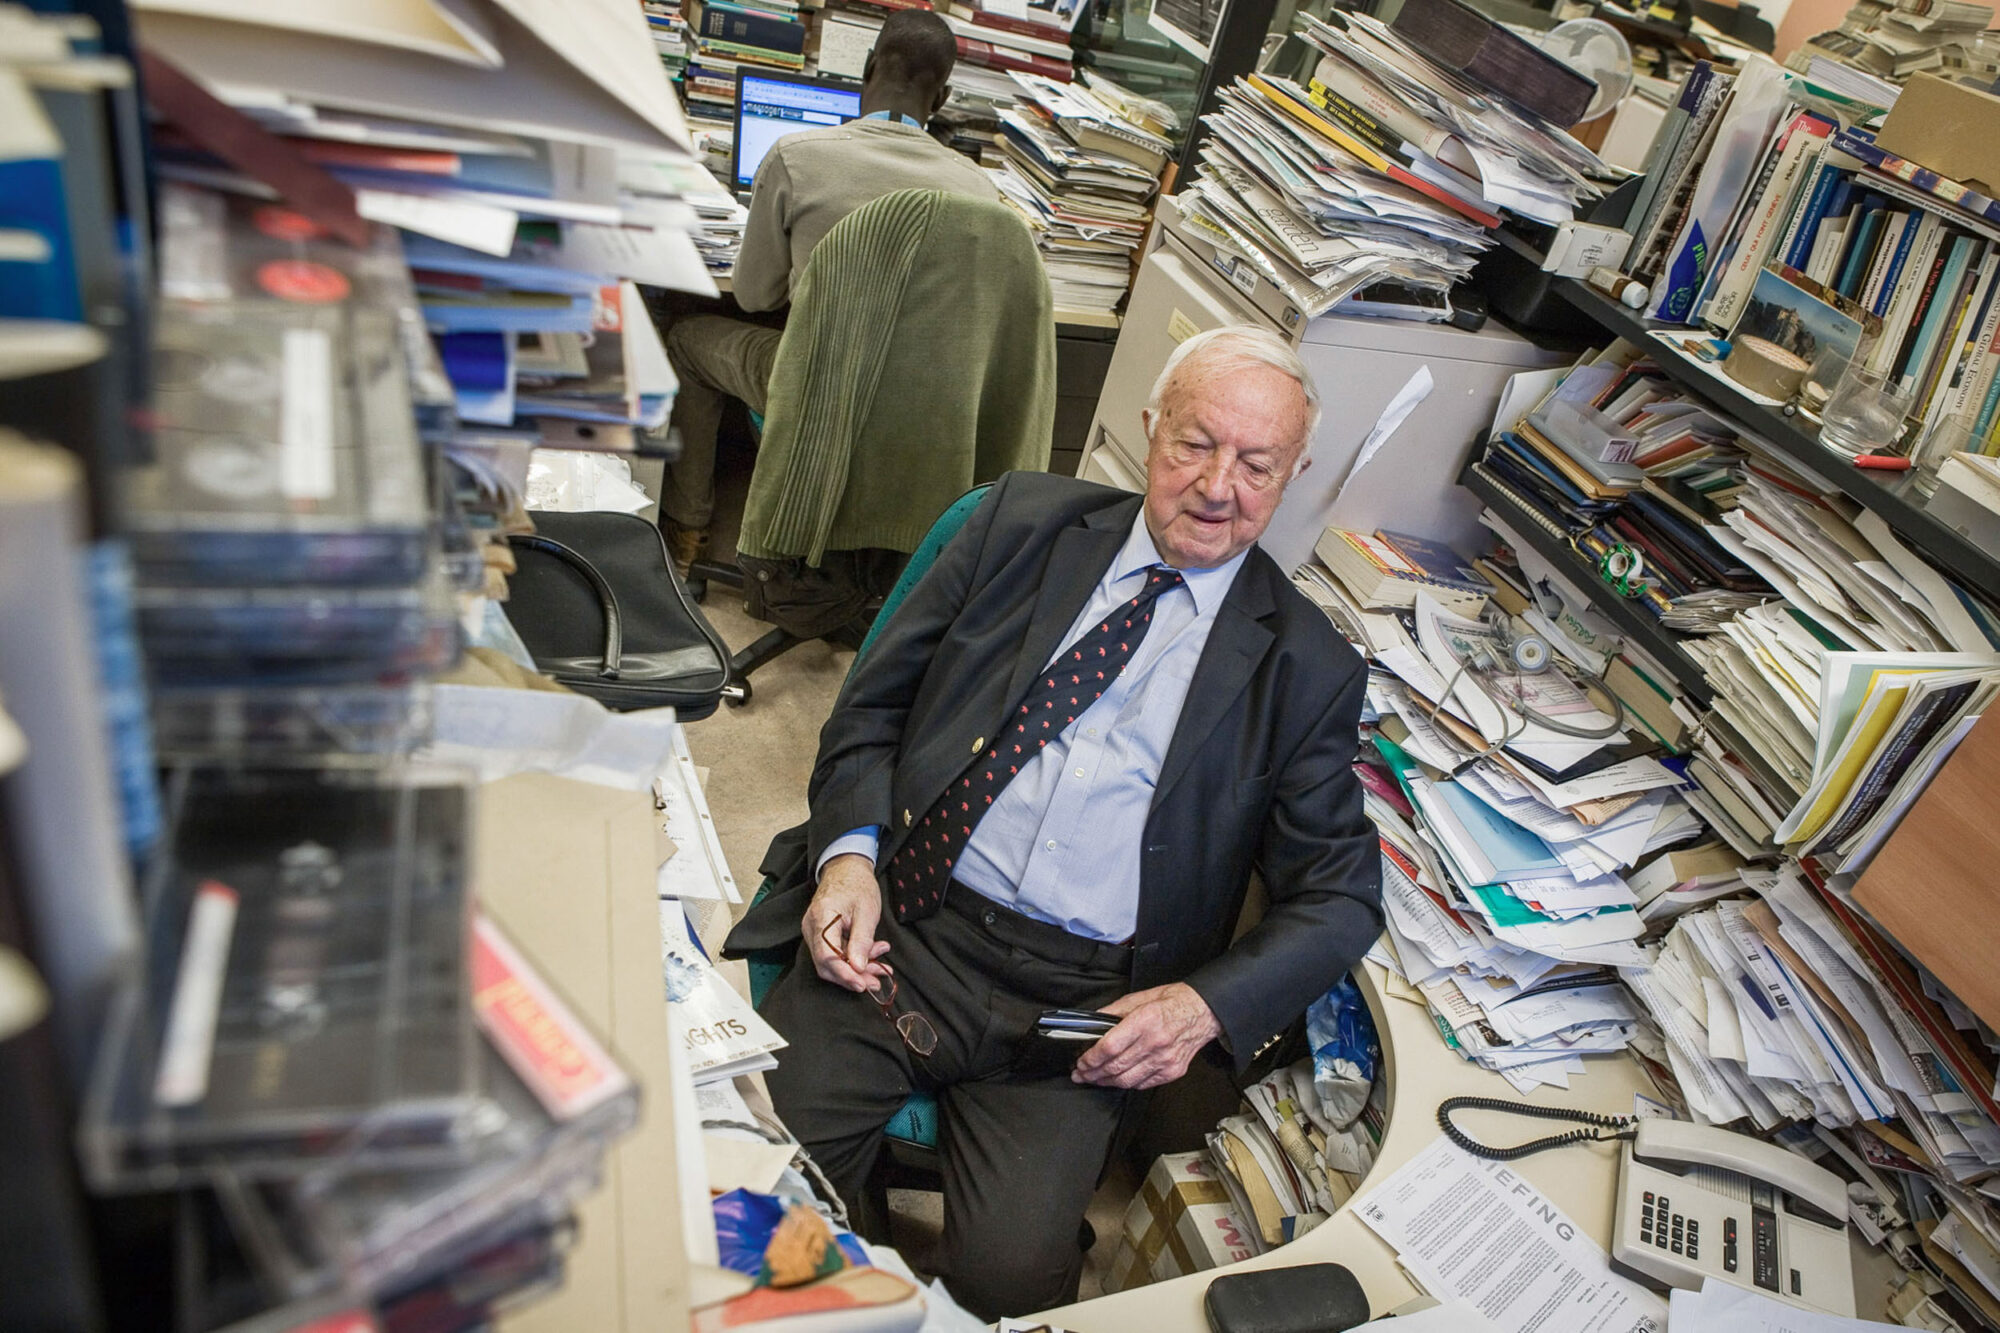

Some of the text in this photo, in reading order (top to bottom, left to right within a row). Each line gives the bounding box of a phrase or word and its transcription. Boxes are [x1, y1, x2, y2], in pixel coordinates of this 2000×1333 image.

[1797, 120, 1811, 133] The
[1257, 208, 1319, 254] garden
[1739, 253, 1752, 272] CEUX
[1748, 237, 1760, 252] QUI
[1754, 218, 1769, 239] FONT
[1933, 256, 1945, 270] The
[1987, 314, 1997, 331] THE
[1973, 333, 1991, 366] GLOBAL
[1956, 370, 1978, 411] ECONOMY
[684, 1018, 747, 1050] IGHTS
[1478, 1158, 1575, 1242] IEFING
